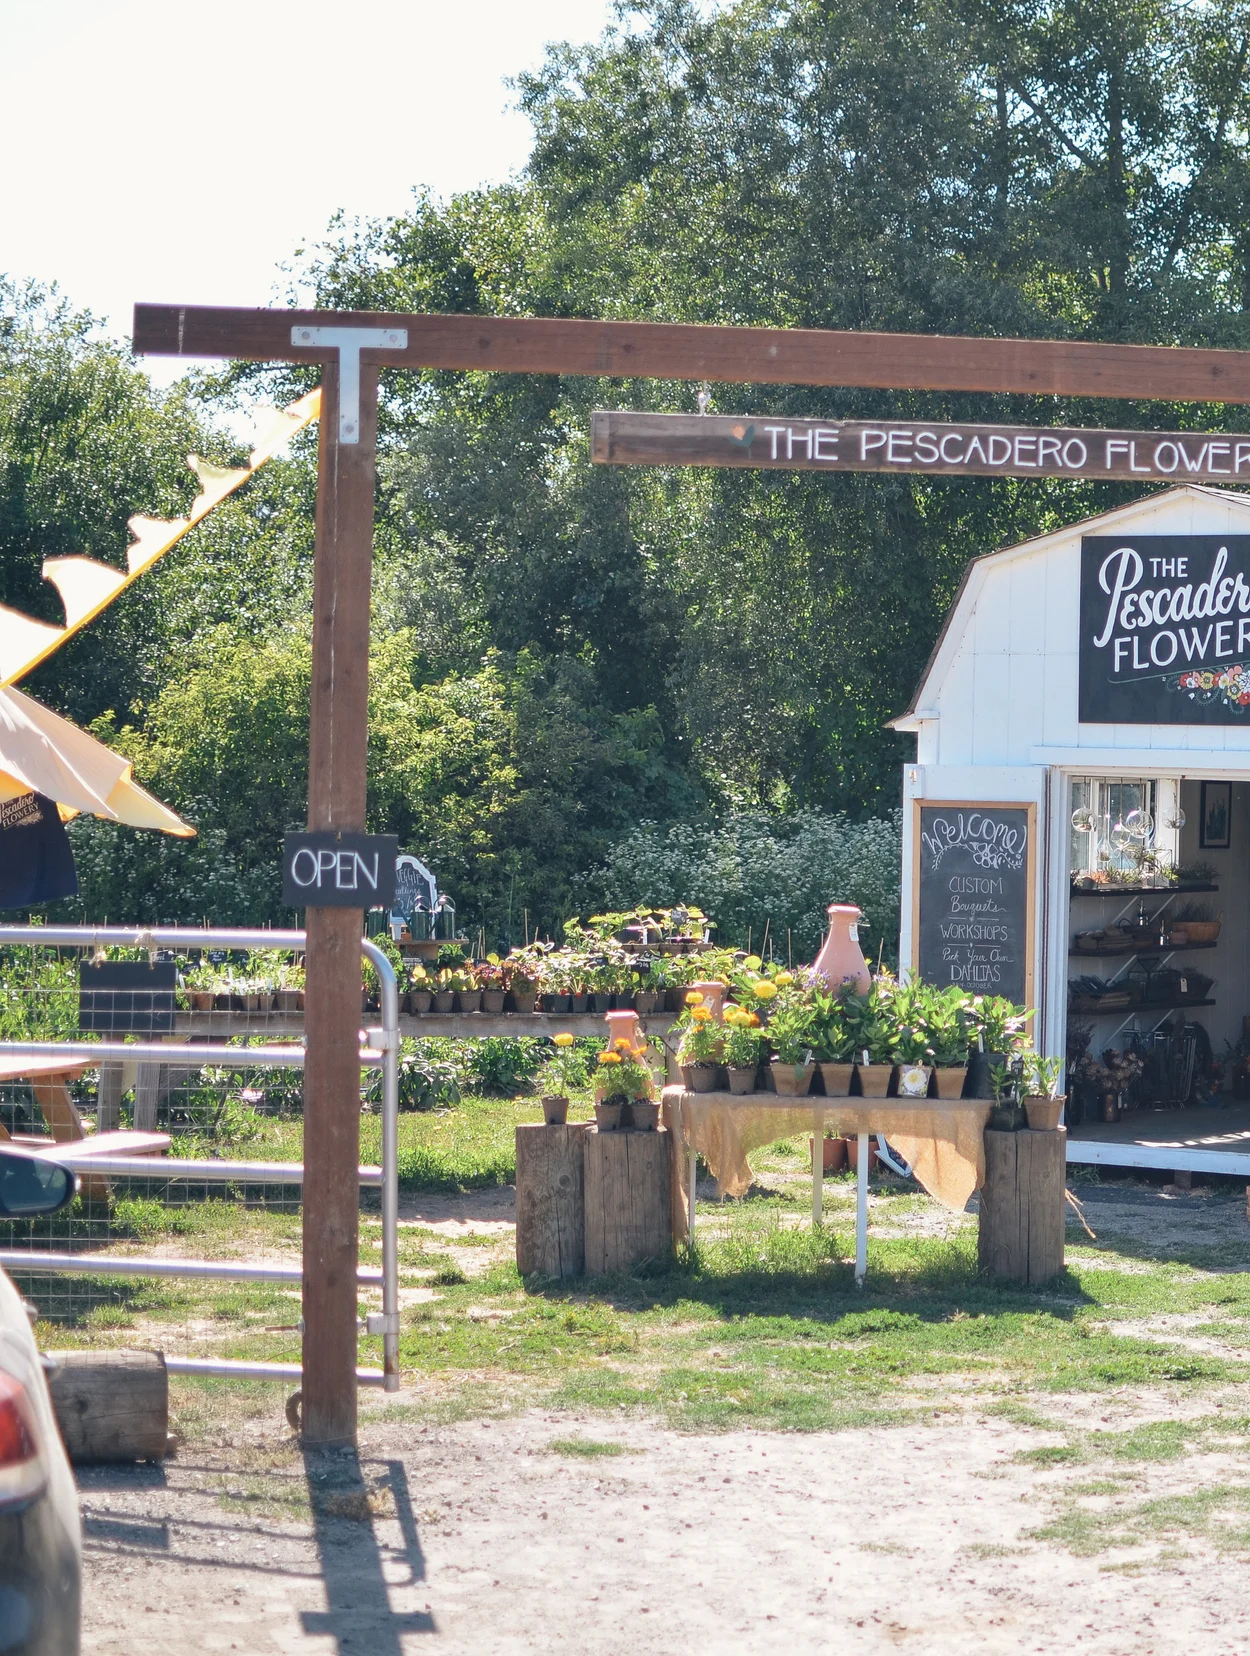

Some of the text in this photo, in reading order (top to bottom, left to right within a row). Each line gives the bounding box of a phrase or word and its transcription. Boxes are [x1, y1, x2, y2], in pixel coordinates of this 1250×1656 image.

[764, 426, 840, 461] THE
[861, 429, 1088, 469] PESCADERO
[1149, 556, 1189, 578] THE
[2, 802, 39, 828] FLOWERY
[921, 812, 1028, 859] Welcome!
[291, 848, 379, 890] OPEN
[948, 875, 1003, 895] CUSTOM
[950, 895, 1007, 915] Bouquets
[940, 922, 1009, 942] WORKSHOPS
[942, 947, 1014, 968] Pick Your Own
[950, 964, 1001, 982] DAHLIAS
